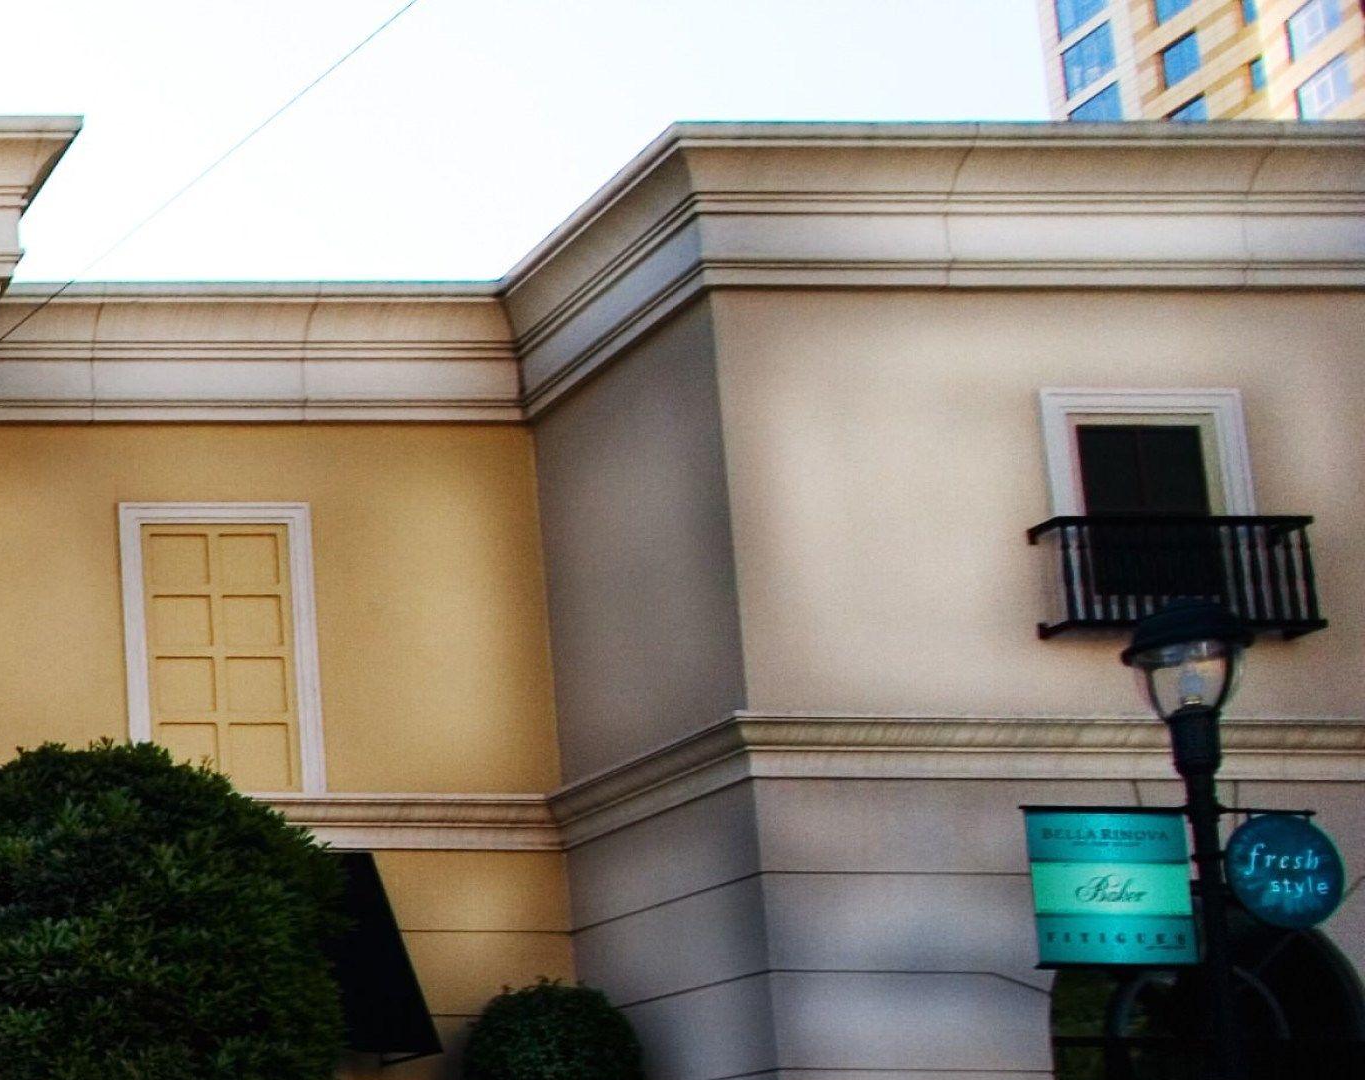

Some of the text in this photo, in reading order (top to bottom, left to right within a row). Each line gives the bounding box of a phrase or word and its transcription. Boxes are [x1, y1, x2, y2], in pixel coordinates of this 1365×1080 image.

[1041, 827, 1096, 841] BELLA
[1243, 842, 1320, 877] fresh
[1074, 873, 1148, 902] Baker
[1269, 875, 1330, 899] style
